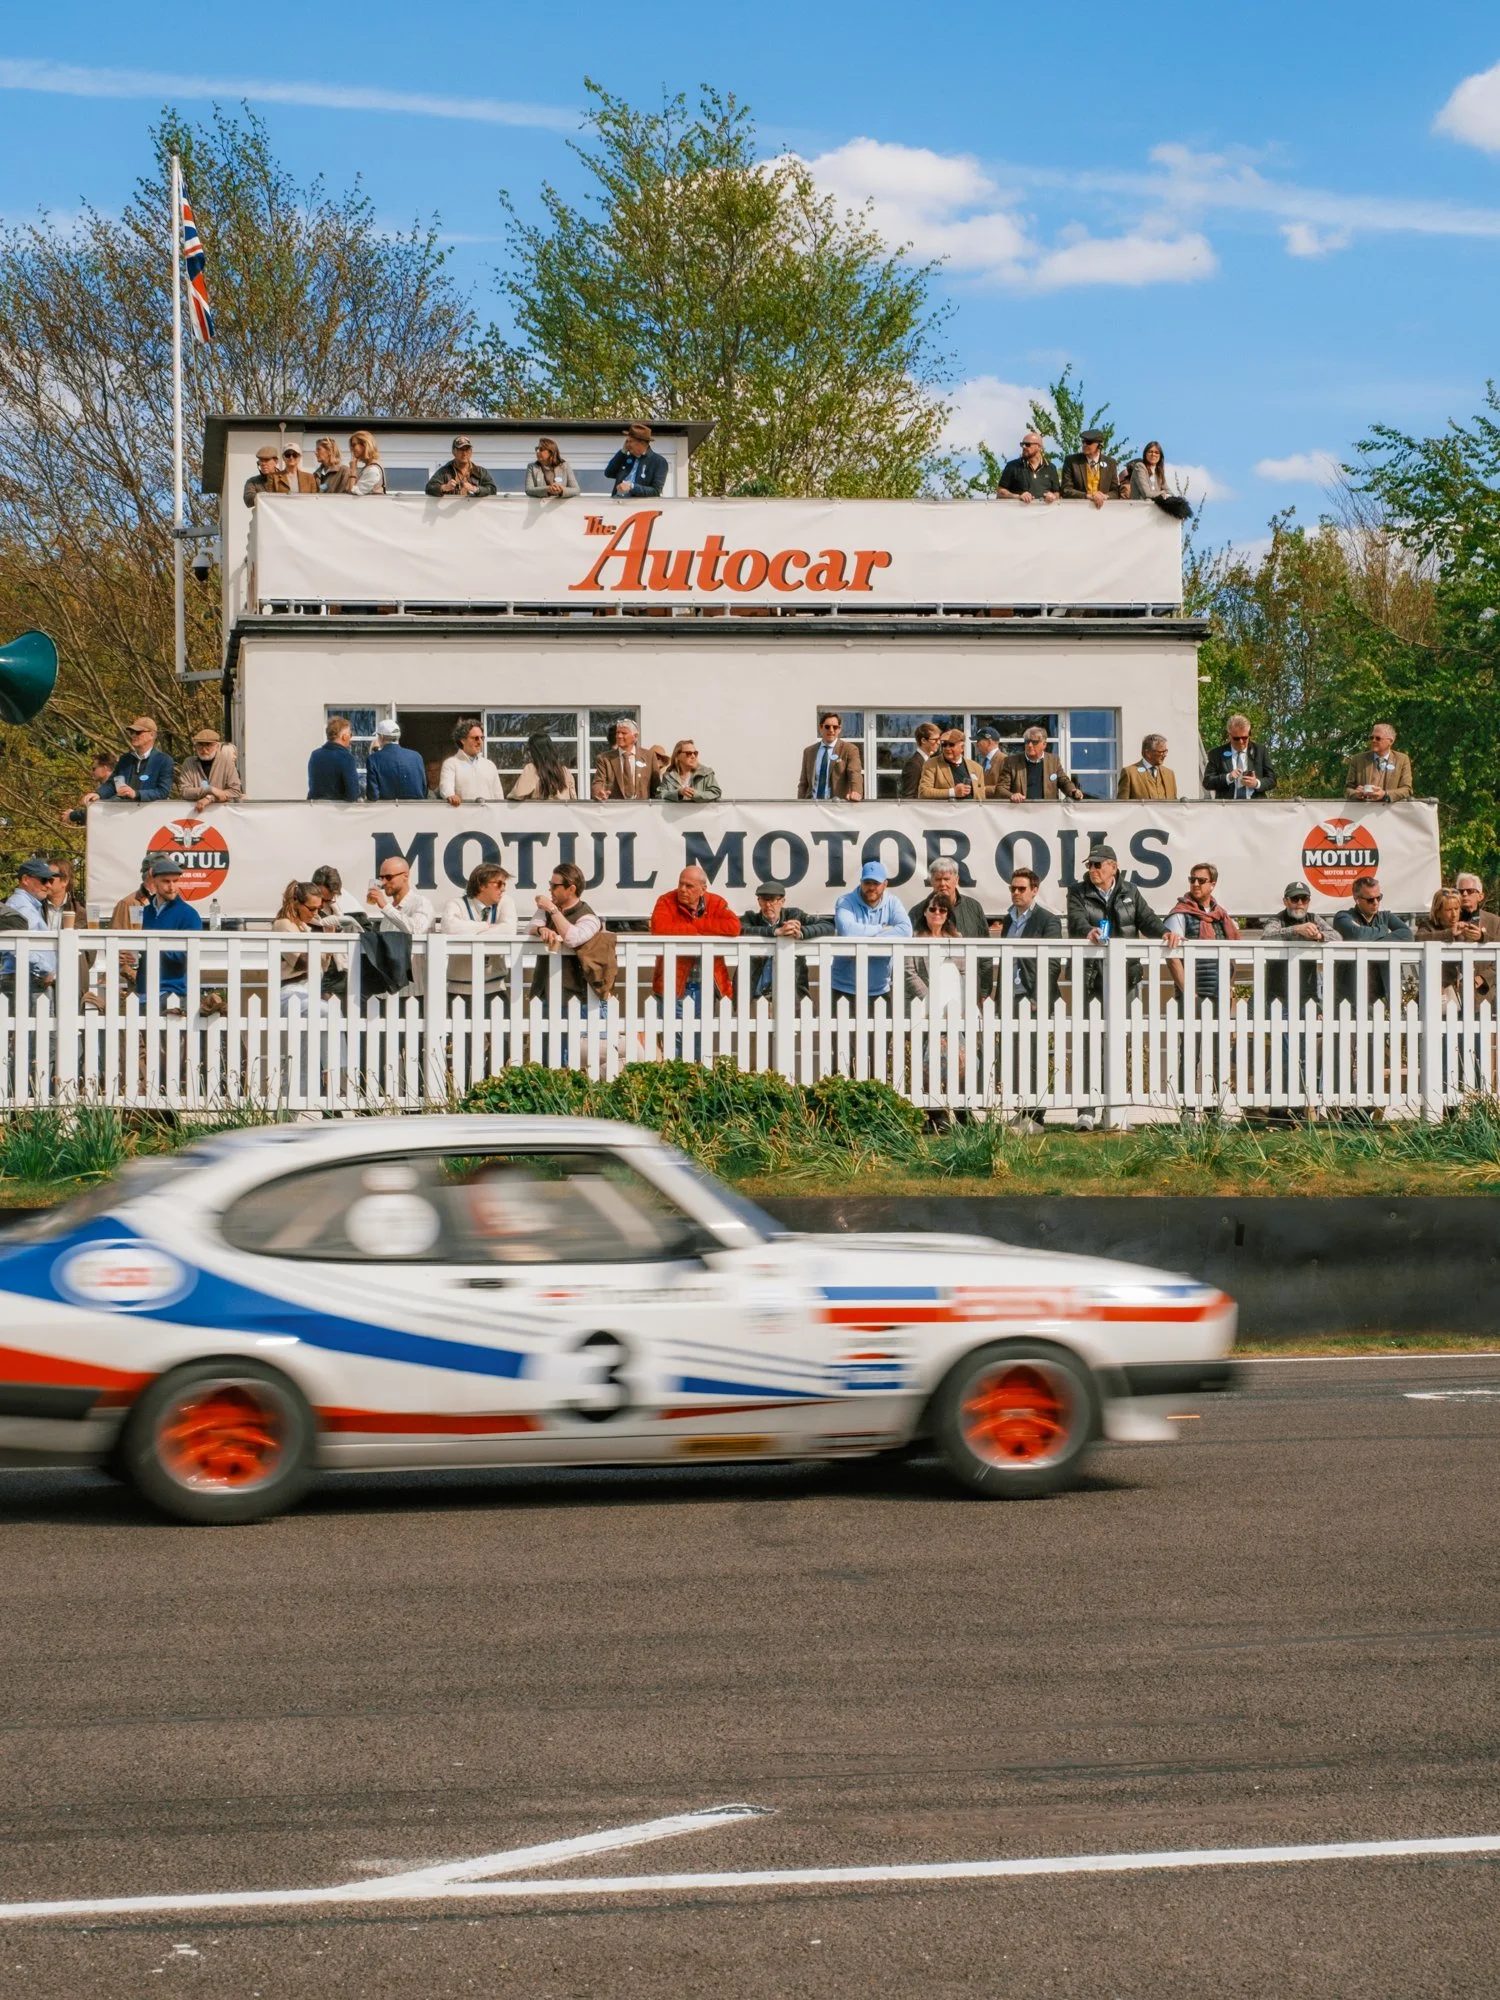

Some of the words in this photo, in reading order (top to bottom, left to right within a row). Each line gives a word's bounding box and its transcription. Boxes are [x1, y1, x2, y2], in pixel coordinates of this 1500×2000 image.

[583, 515, 616, 535] The
[568, 510, 892, 592] Autocar
[149, 851, 226, 868] OTUL
[371, 830, 658, 890] MOTUL
[682, 829, 977, 889] MOTOR
[994, 828, 1173, 889] OIS
[1305, 850, 1376, 866] MOTUL
[567, 1329, 634, 1423] 3
